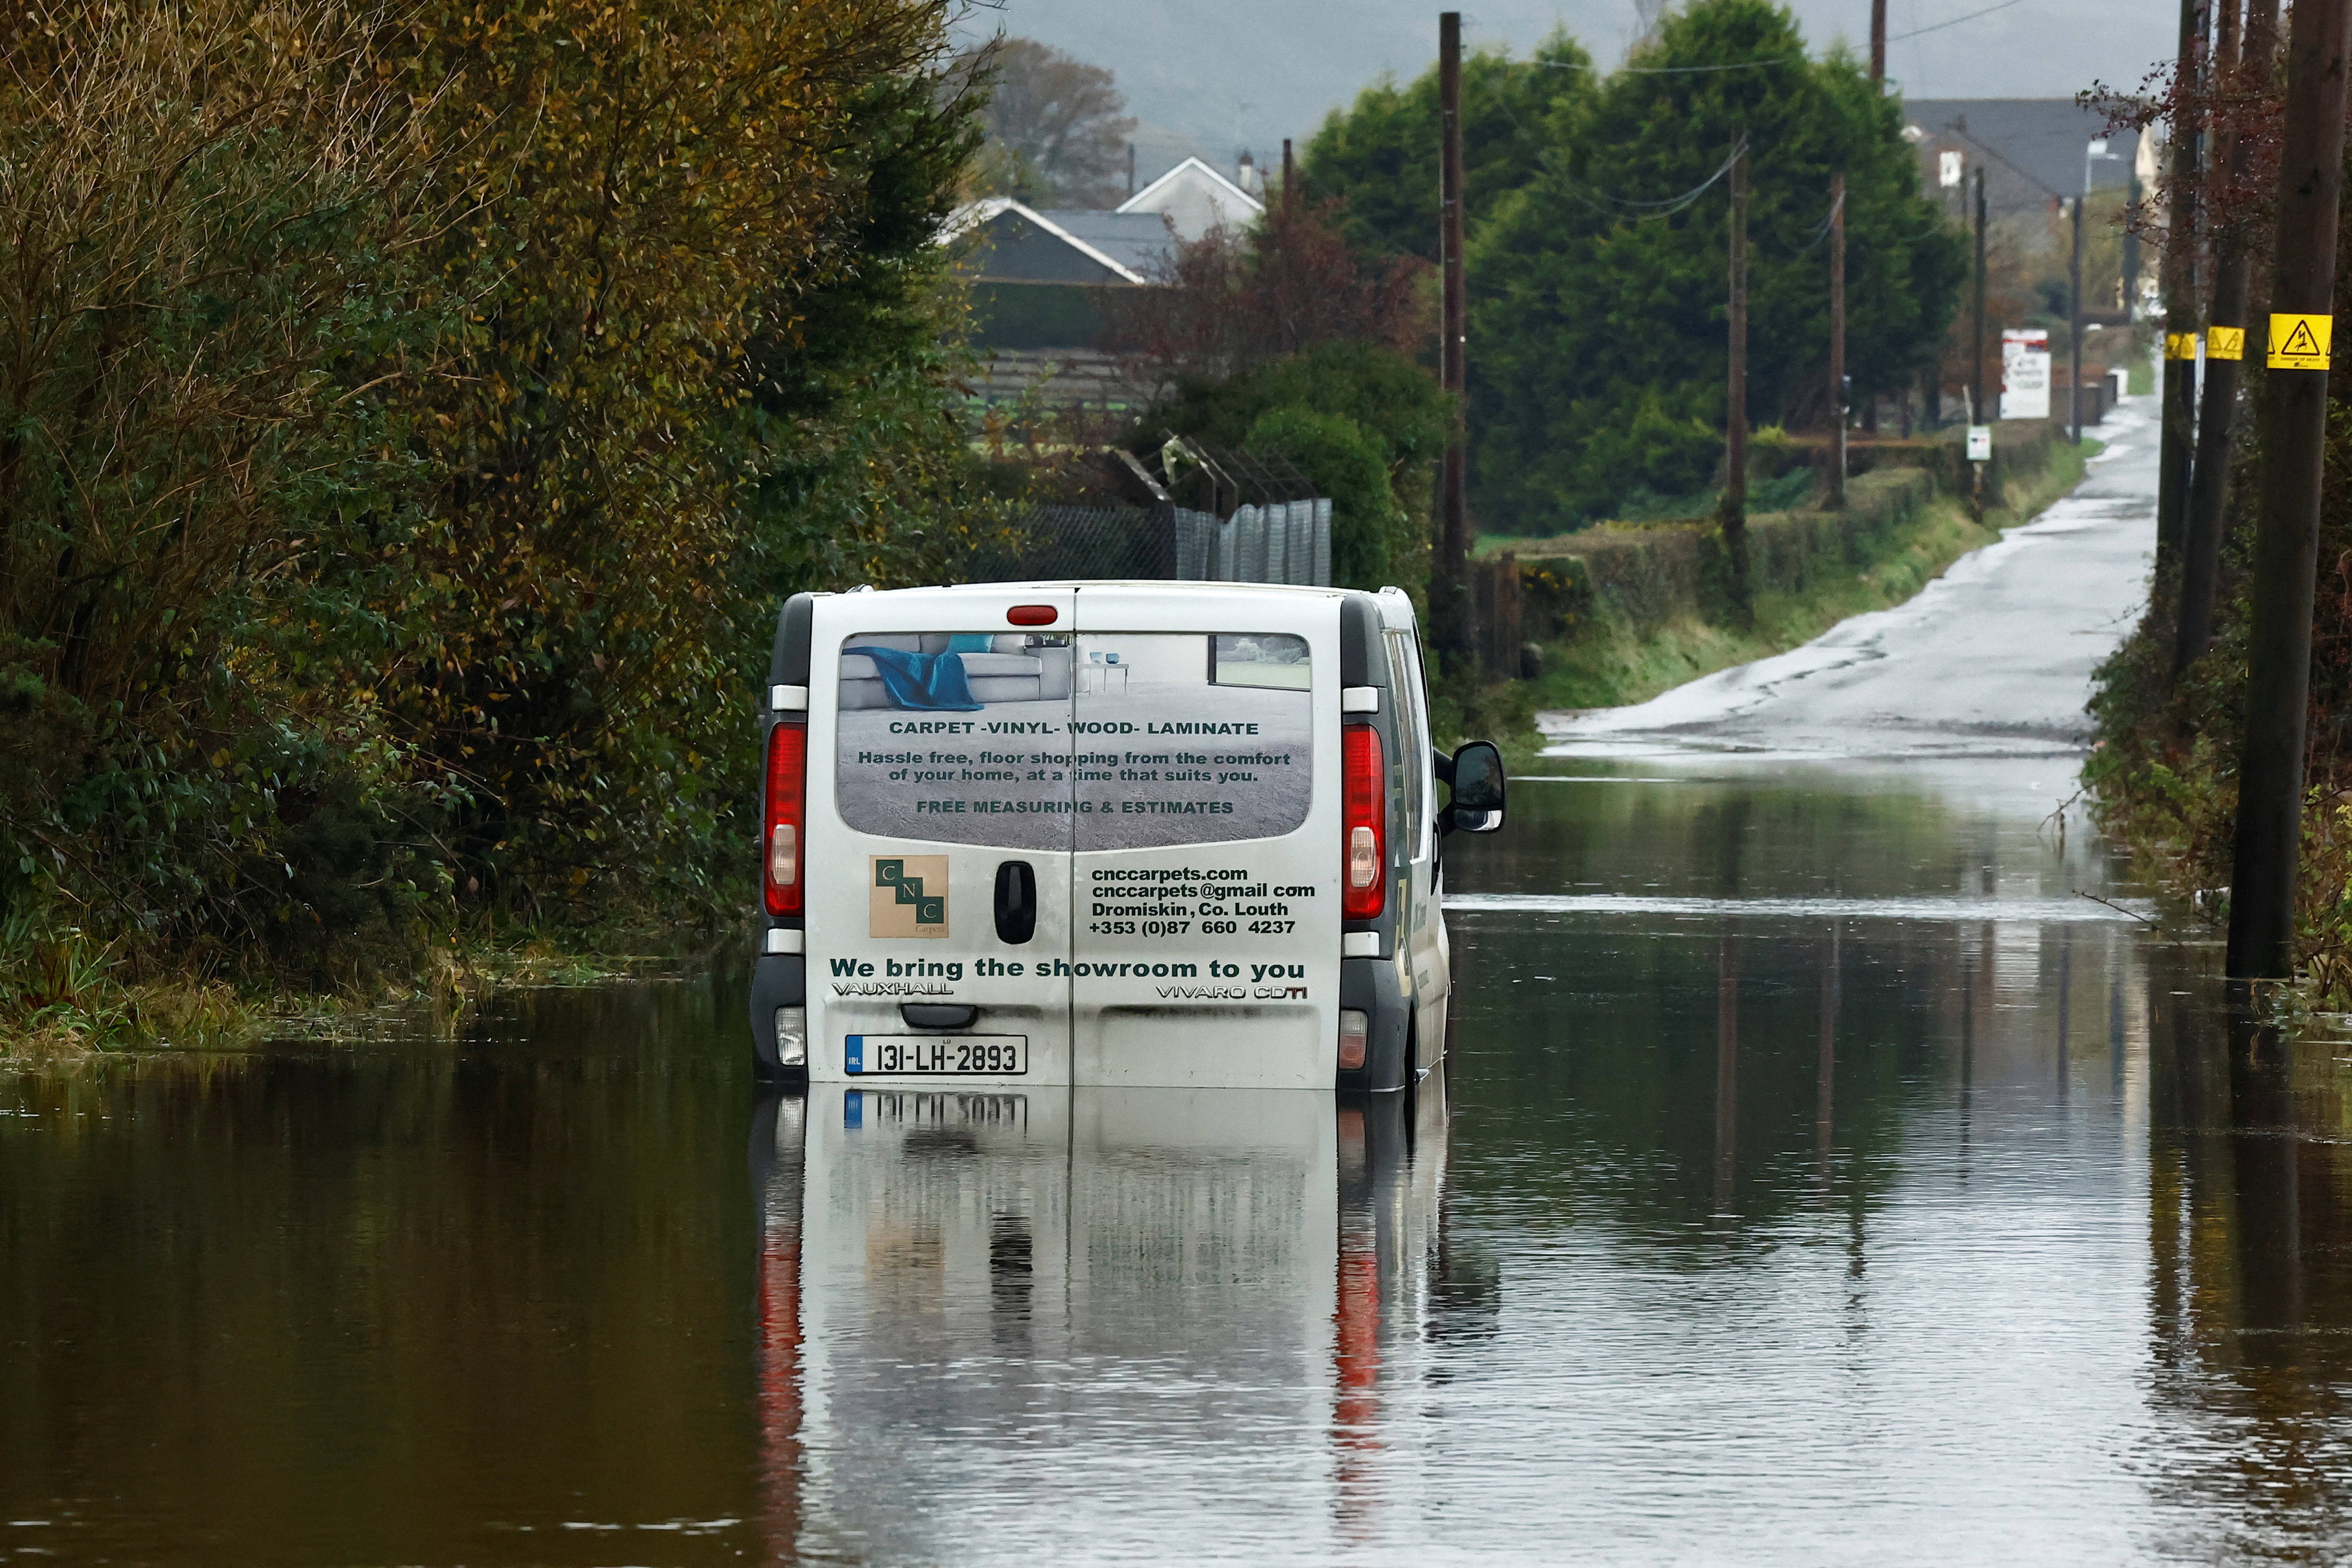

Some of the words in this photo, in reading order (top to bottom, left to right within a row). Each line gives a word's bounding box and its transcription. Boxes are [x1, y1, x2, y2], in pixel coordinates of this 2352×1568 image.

[889, 722, 975, 734] CARPET
[981, 722, 1060, 734] -VINYL-
[1067, 722, 1140, 734] WOOD-
[1148, 723, 1259, 735] LAMINATE
[859, 751, 923, 764] Hassle
[930, 751, 973, 766] free,
[980, 752, 1024, 764] floor
[1031, 751, 1118, 767] shopping
[1125, 752, 1169, 764] from
[1176, 753, 1207, 764] the
[1214, 753, 1290, 765] comfort
[889, 769, 907, 780] of
[914, 771, 955, 783] your
[962, 769, 1020, 783] home,
[1026, 769, 1045, 780] at
[1052, 771, 1062, 780] a
[1069, 769, 1112, 781] time
[1120, 769, 1158, 781] that
[1165, 769, 1212, 781] suits
[1218, 771, 1258, 784] you.
[917, 802, 966, 813] FREE
[973, 802, 1092, 813] MEASURING
[1100, 802, 1114, 813] &
[1122, 802, 1233, 813] ESTIMATES
[1092, 867, 1248, 884] cnccarpets.com
[1093, 883, 1267, 900] cnccarpets@gmail
[1199, 903, 1228, 916] Co.
[1235, 903, 1288, 916] Louth
[1089, 922, 1136, 934] +353
[1142, 921, 1190, 937] (0)87
[1202, 921, 1237, 934] 660
[1248, 921, 1295, 933] 4237
[830, 958, 875, 976] We
[886, 958, 963, 980] bring
[975, 958, 1024, 976] the
[1036, 958, 1197, 977] showroom
[1209, 960, 1240, 977] to
[1251, 964, 1304, 982] you
[831, 983, 954, 995] VAUXHALL
[1156, 985, 1246, 998] VIVARO
[878, 1045, 1016, 1070] 131-LH-2893
